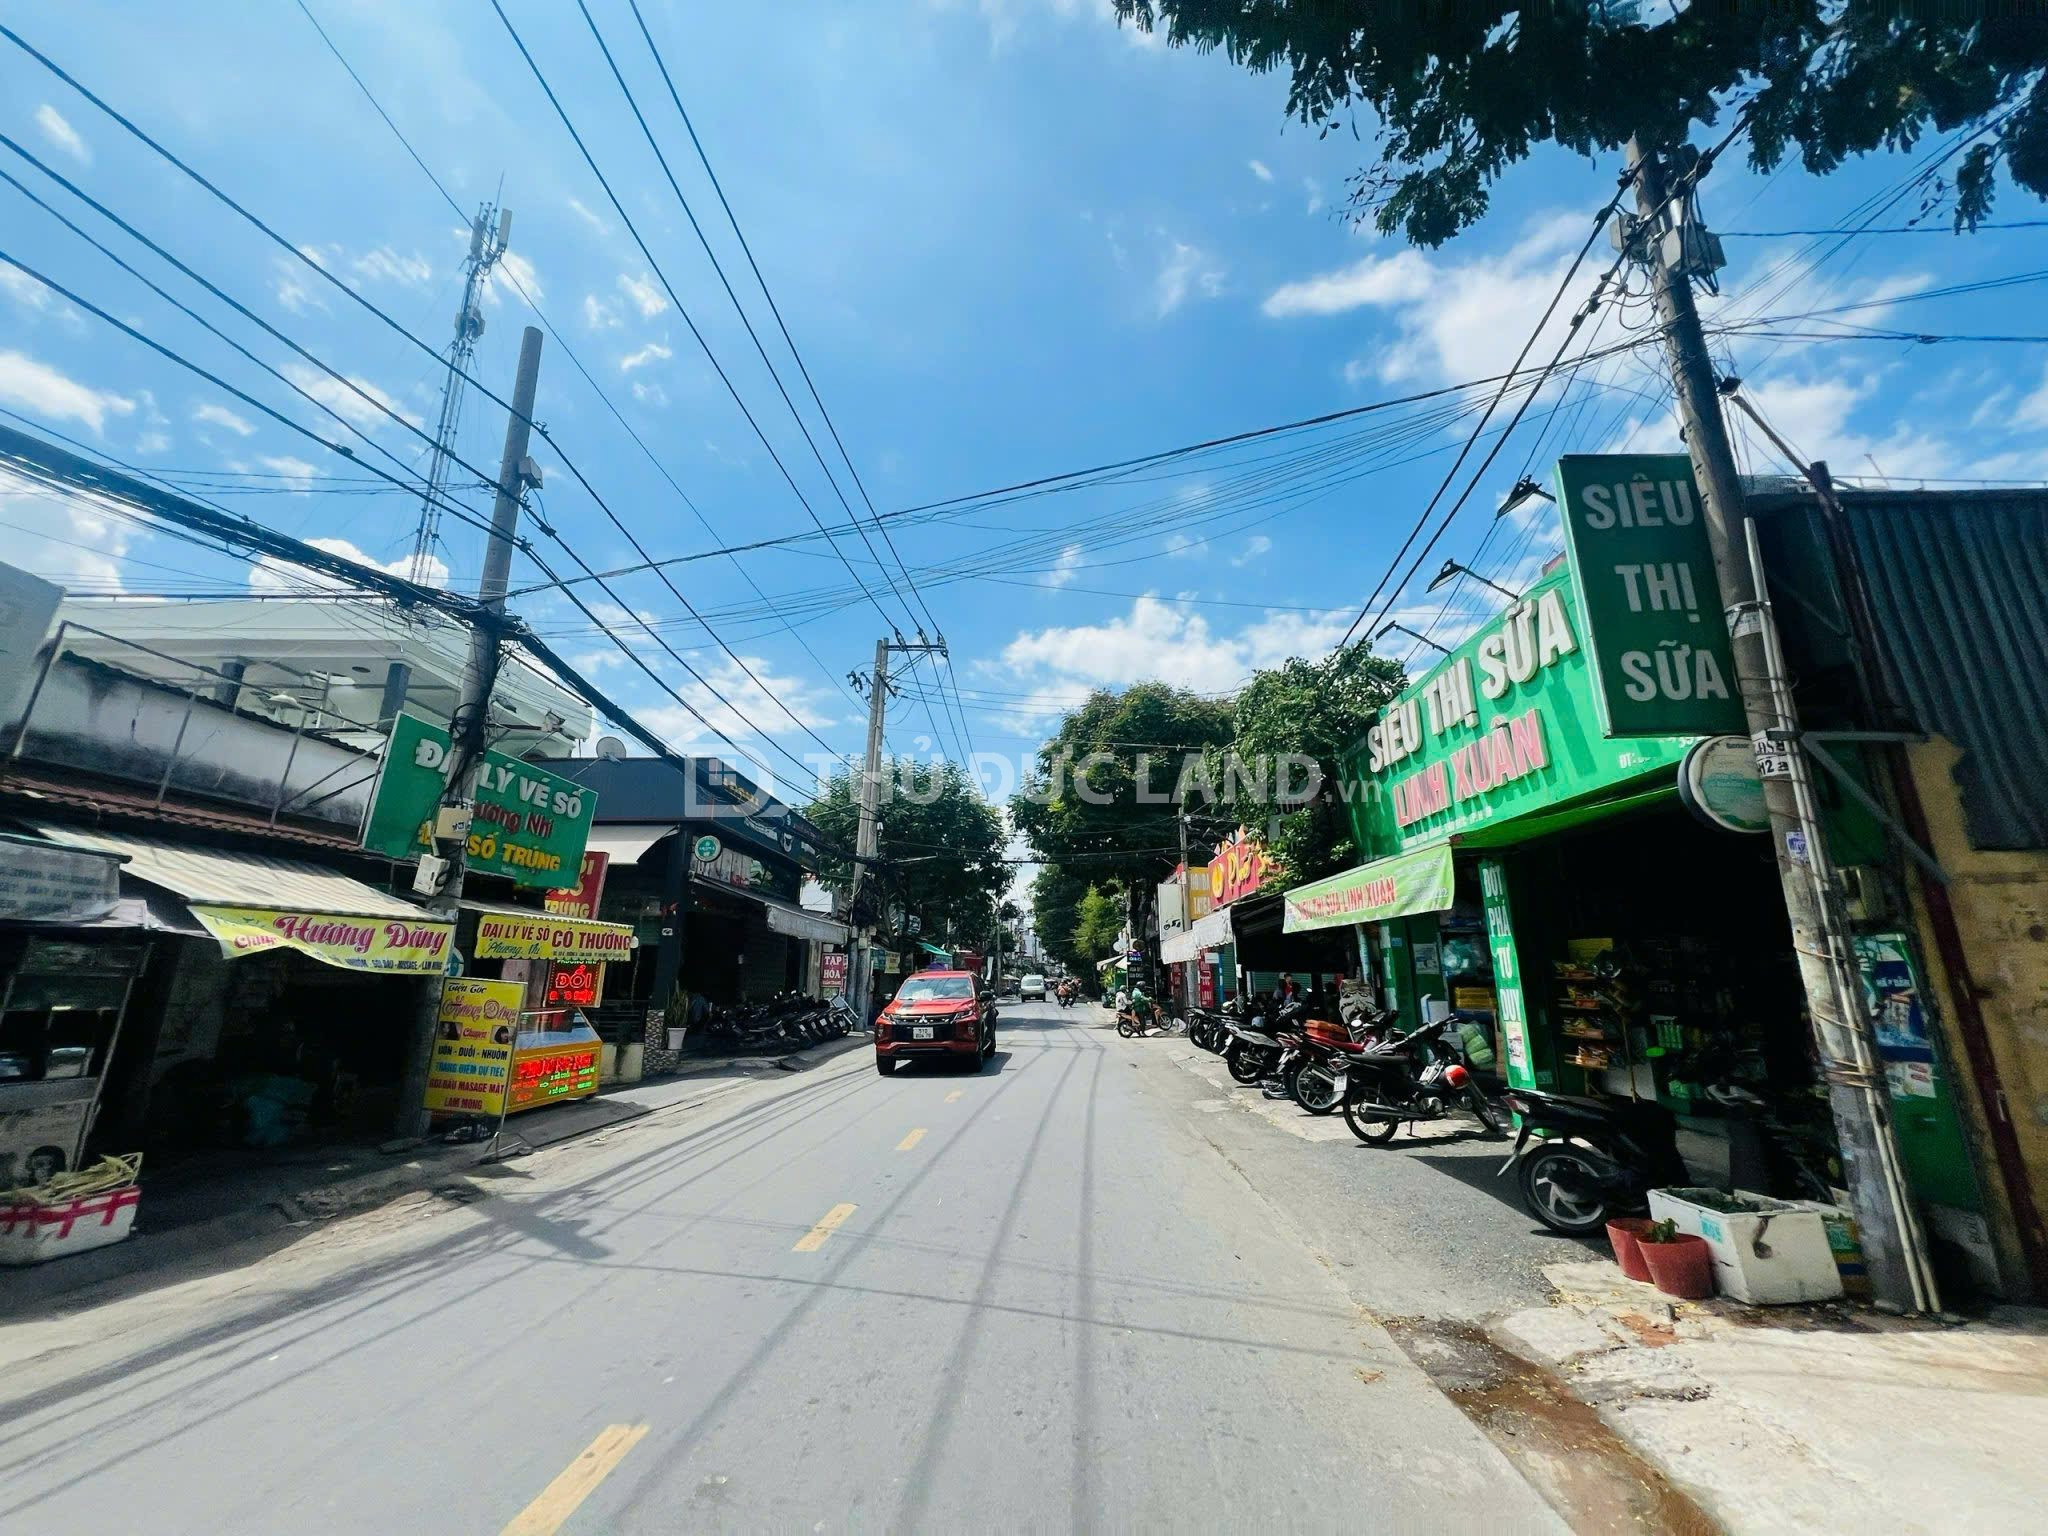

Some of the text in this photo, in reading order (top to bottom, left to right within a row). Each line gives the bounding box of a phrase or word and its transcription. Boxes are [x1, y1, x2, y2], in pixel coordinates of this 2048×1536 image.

[1581, 473, 1695, 530] SIÊU
[1614, 562, 1701, 623] THỊ
[1367, 587, 1579, 773] SIÊU THỊ SỮA
[1620, 639, 1730, 702] SỮA
[479, 762, 588, 819] LÝ VÉ SỐ
[1392, 760, 1451, 829] LINH
[1450, 708, 1550, 802] XUÂN
[552, 927, 574, 949] CÓ
[579, 929, 632, 951] THƯỞNG
[554, 964, 592, 988] ĐỔI
